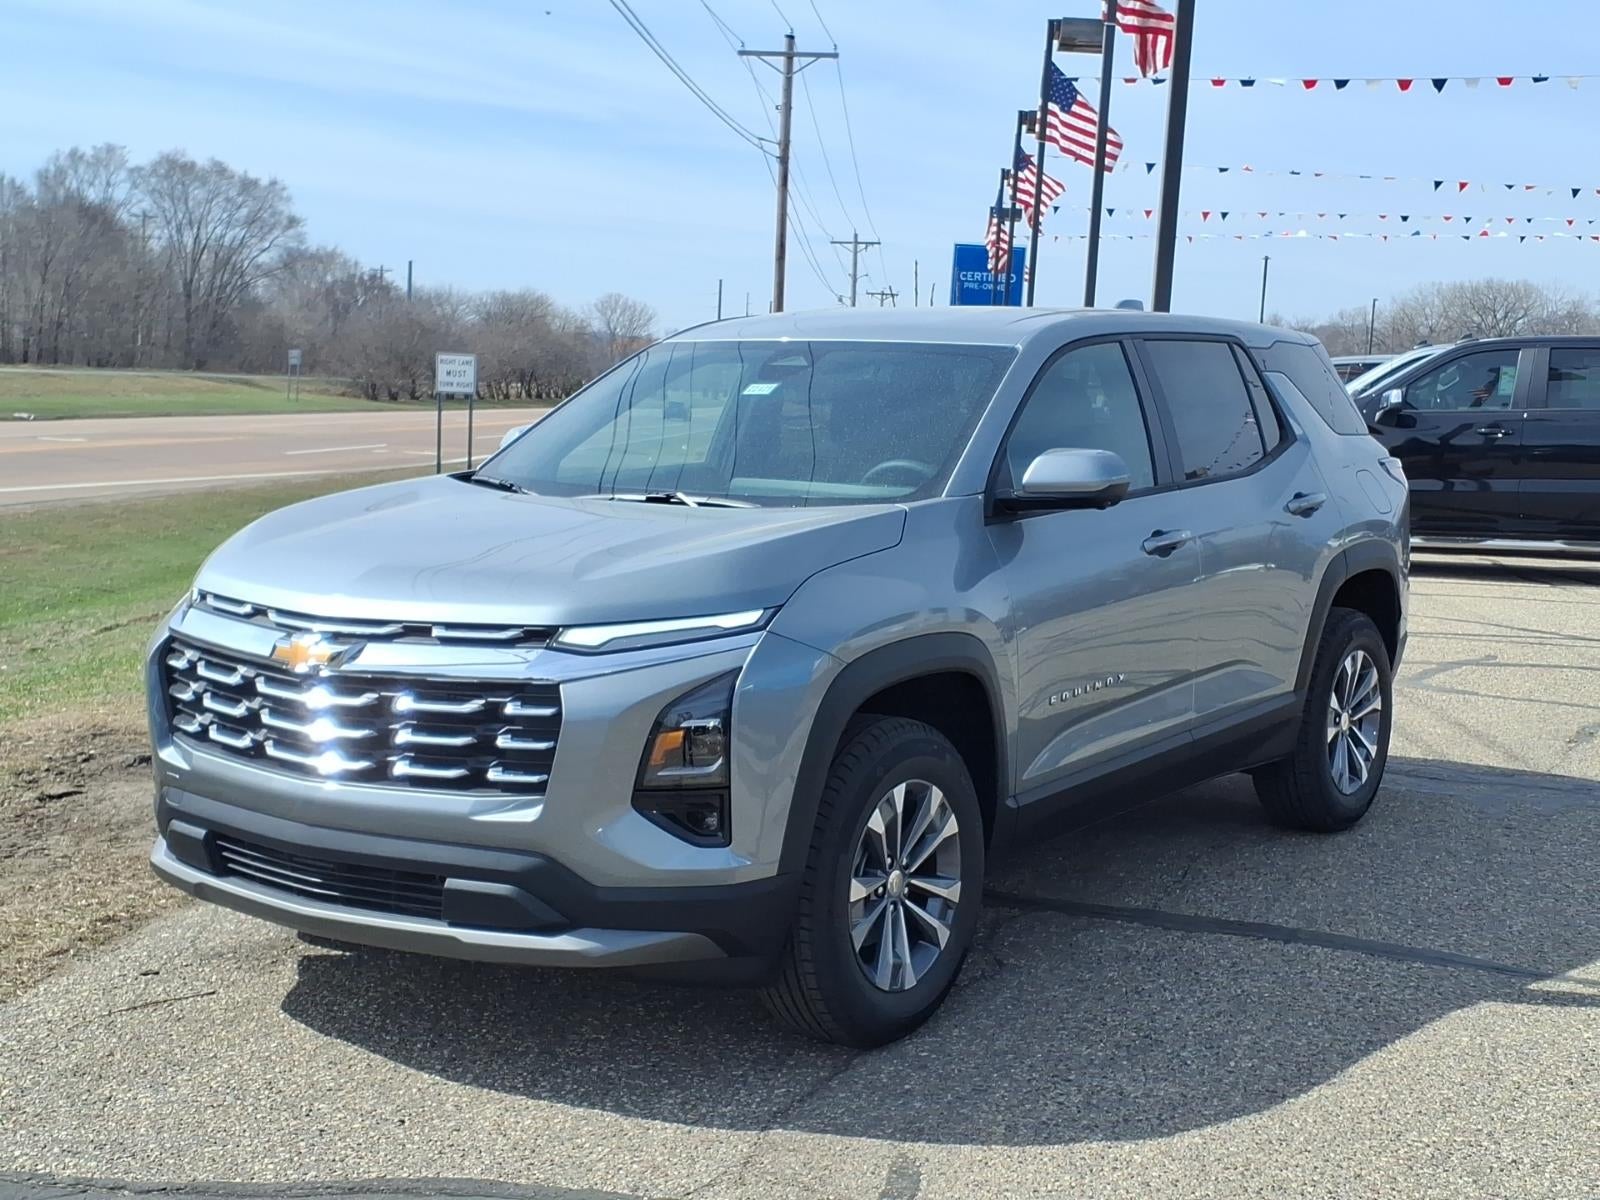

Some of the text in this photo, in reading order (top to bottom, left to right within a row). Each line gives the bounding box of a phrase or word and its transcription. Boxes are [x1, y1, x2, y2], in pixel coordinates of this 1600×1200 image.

[963, 282, 1009, 291] PRE-OWNE
[446, 369, 467, 378] MUST
[1048, 673, 1125, 706] EQUINOX
